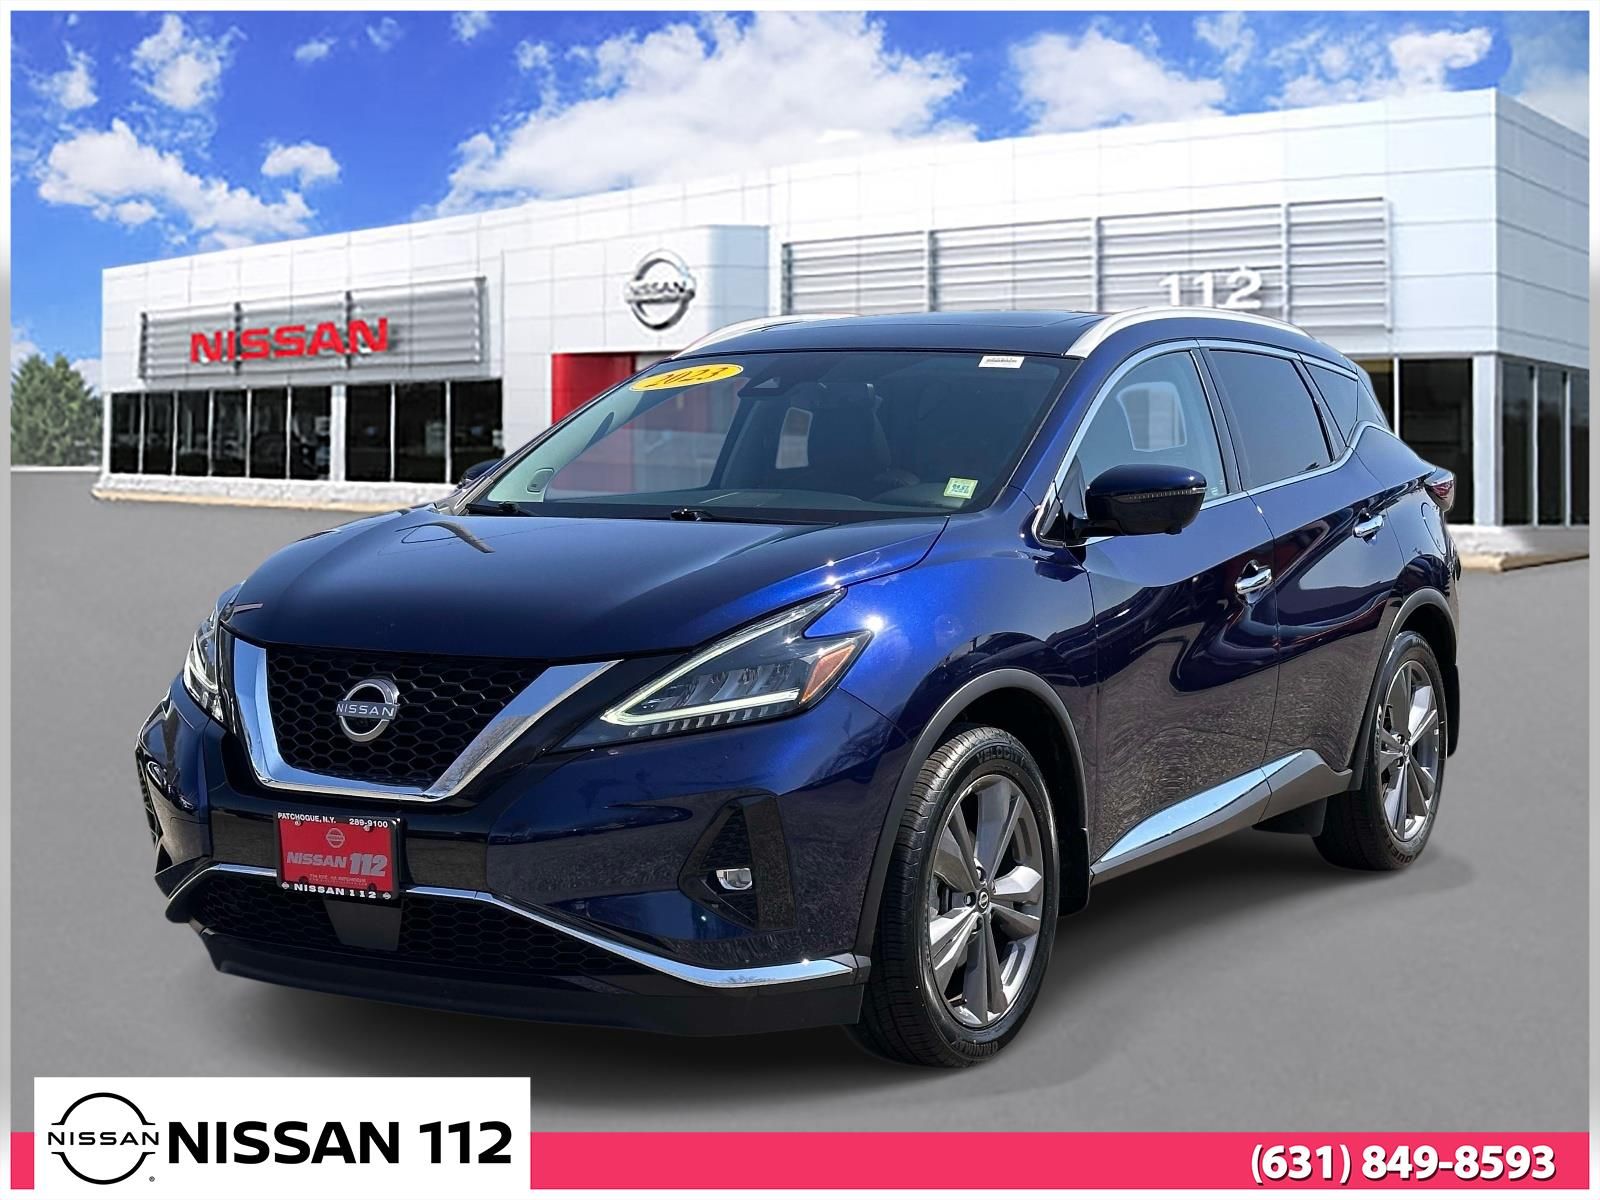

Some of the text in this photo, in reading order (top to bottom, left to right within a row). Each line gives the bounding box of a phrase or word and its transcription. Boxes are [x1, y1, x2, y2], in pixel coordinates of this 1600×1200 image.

[1159, 268, 1262, 309] 112
[190, 317, 389, 364] NISSAN
[643, 366, 730, 388] 2023
[336, 703, 396, 717] NISSAN
[349, 818, 389, 829] 289-9100
[286, 851, 388, 877] NISSAN 112
[293, 883, 345, 897] NISSAN
